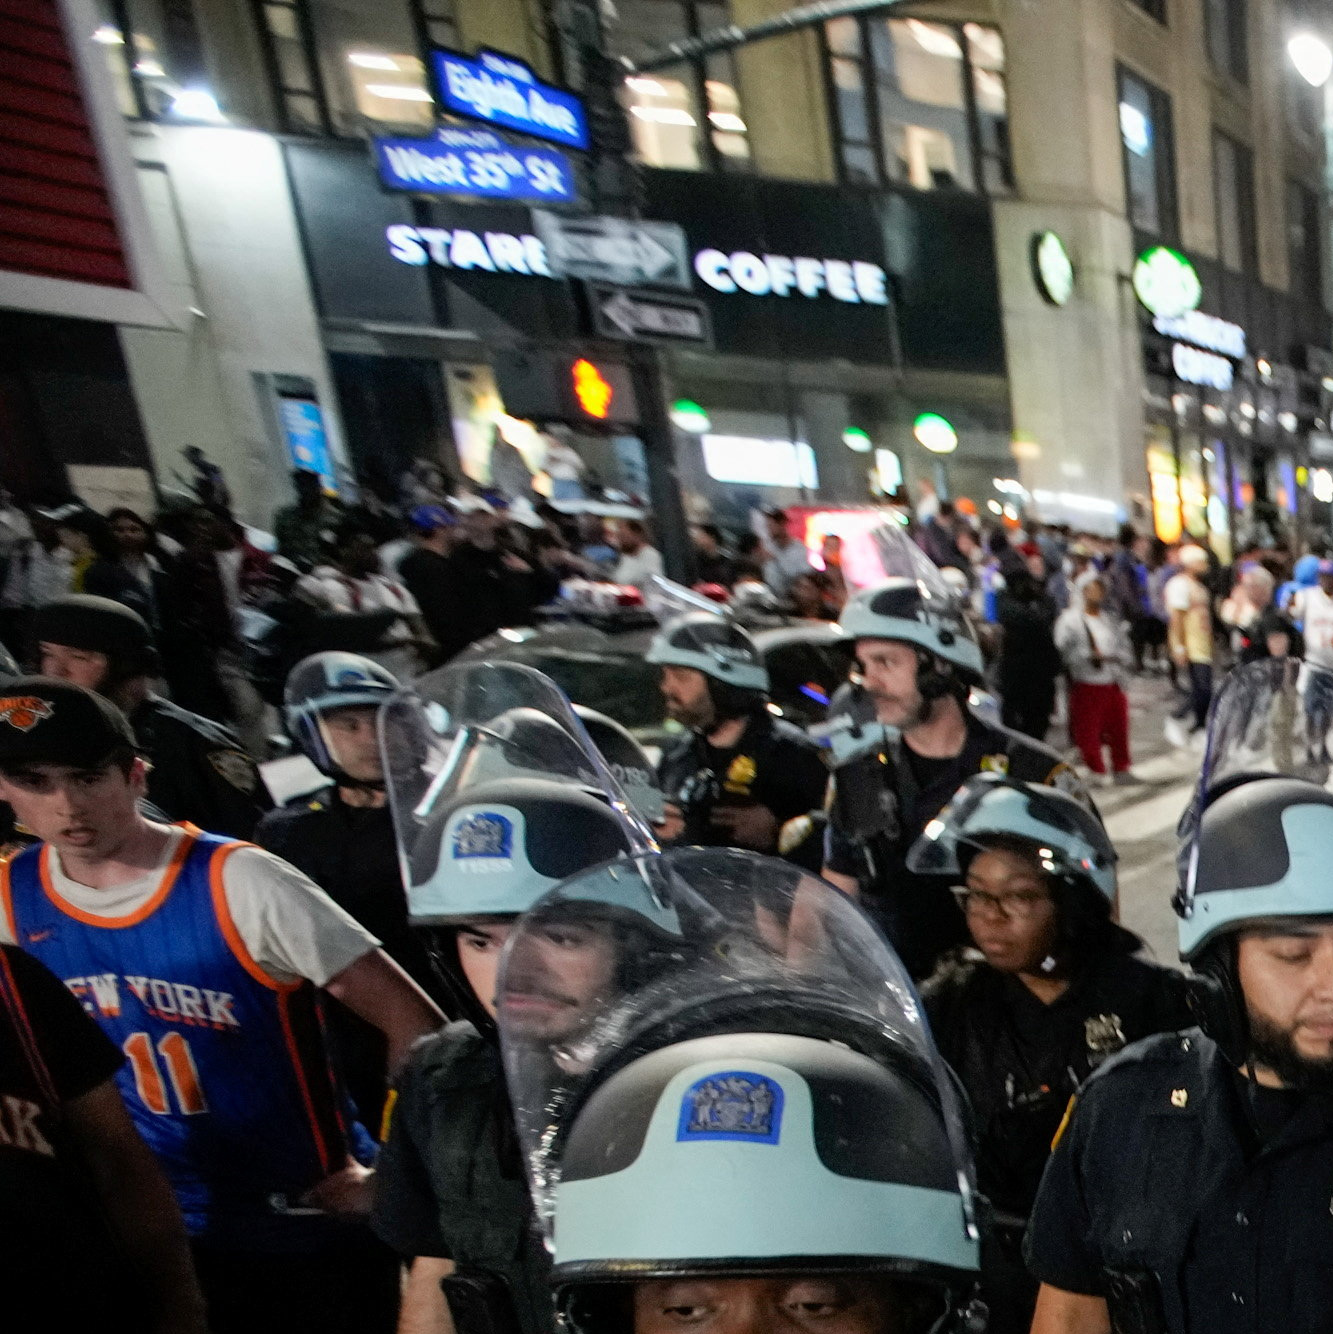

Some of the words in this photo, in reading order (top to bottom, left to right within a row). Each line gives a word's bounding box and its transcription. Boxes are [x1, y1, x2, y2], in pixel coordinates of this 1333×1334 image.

[444, 60, 528, 119] Eighth
[528, 88, 580, 139] Ave
[384, 145, 471, 188] West
[524, 155, 568, 195] St
[386, 224, 555, 279] STARB
[694, 247, 890, 305] COFFEE
[62, 973, 121, 1017] EW
[124, 975, 241, 1029] YORK
[122, 1031, 210, 1116] 11
